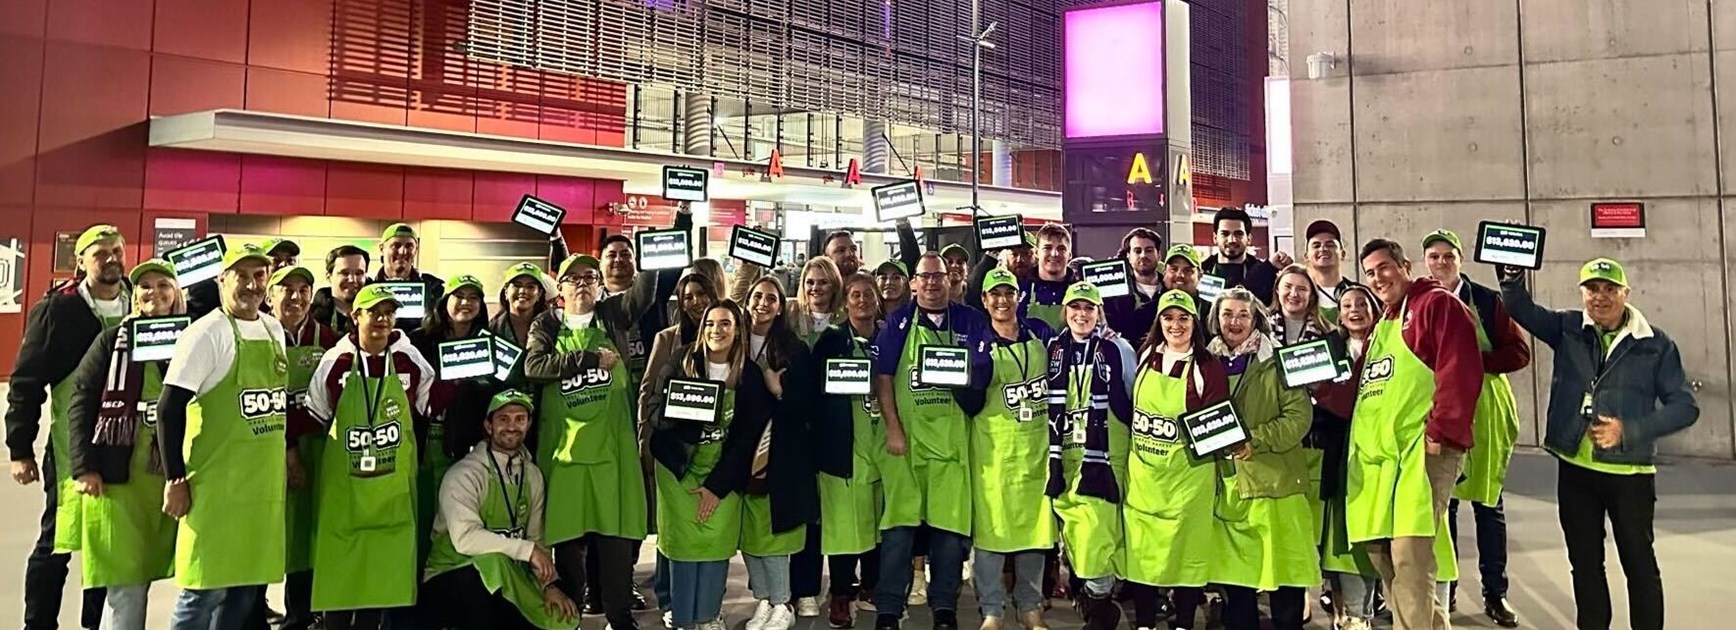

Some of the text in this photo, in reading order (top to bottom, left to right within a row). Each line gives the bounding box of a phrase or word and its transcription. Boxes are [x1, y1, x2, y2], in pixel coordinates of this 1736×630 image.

[1127, 152, 1152, 184] A
[566, 394, 607, 409] Volunteer
[1133, 411, 1177, 437] 50-50
[349, 425, 399, 448] 50-50
